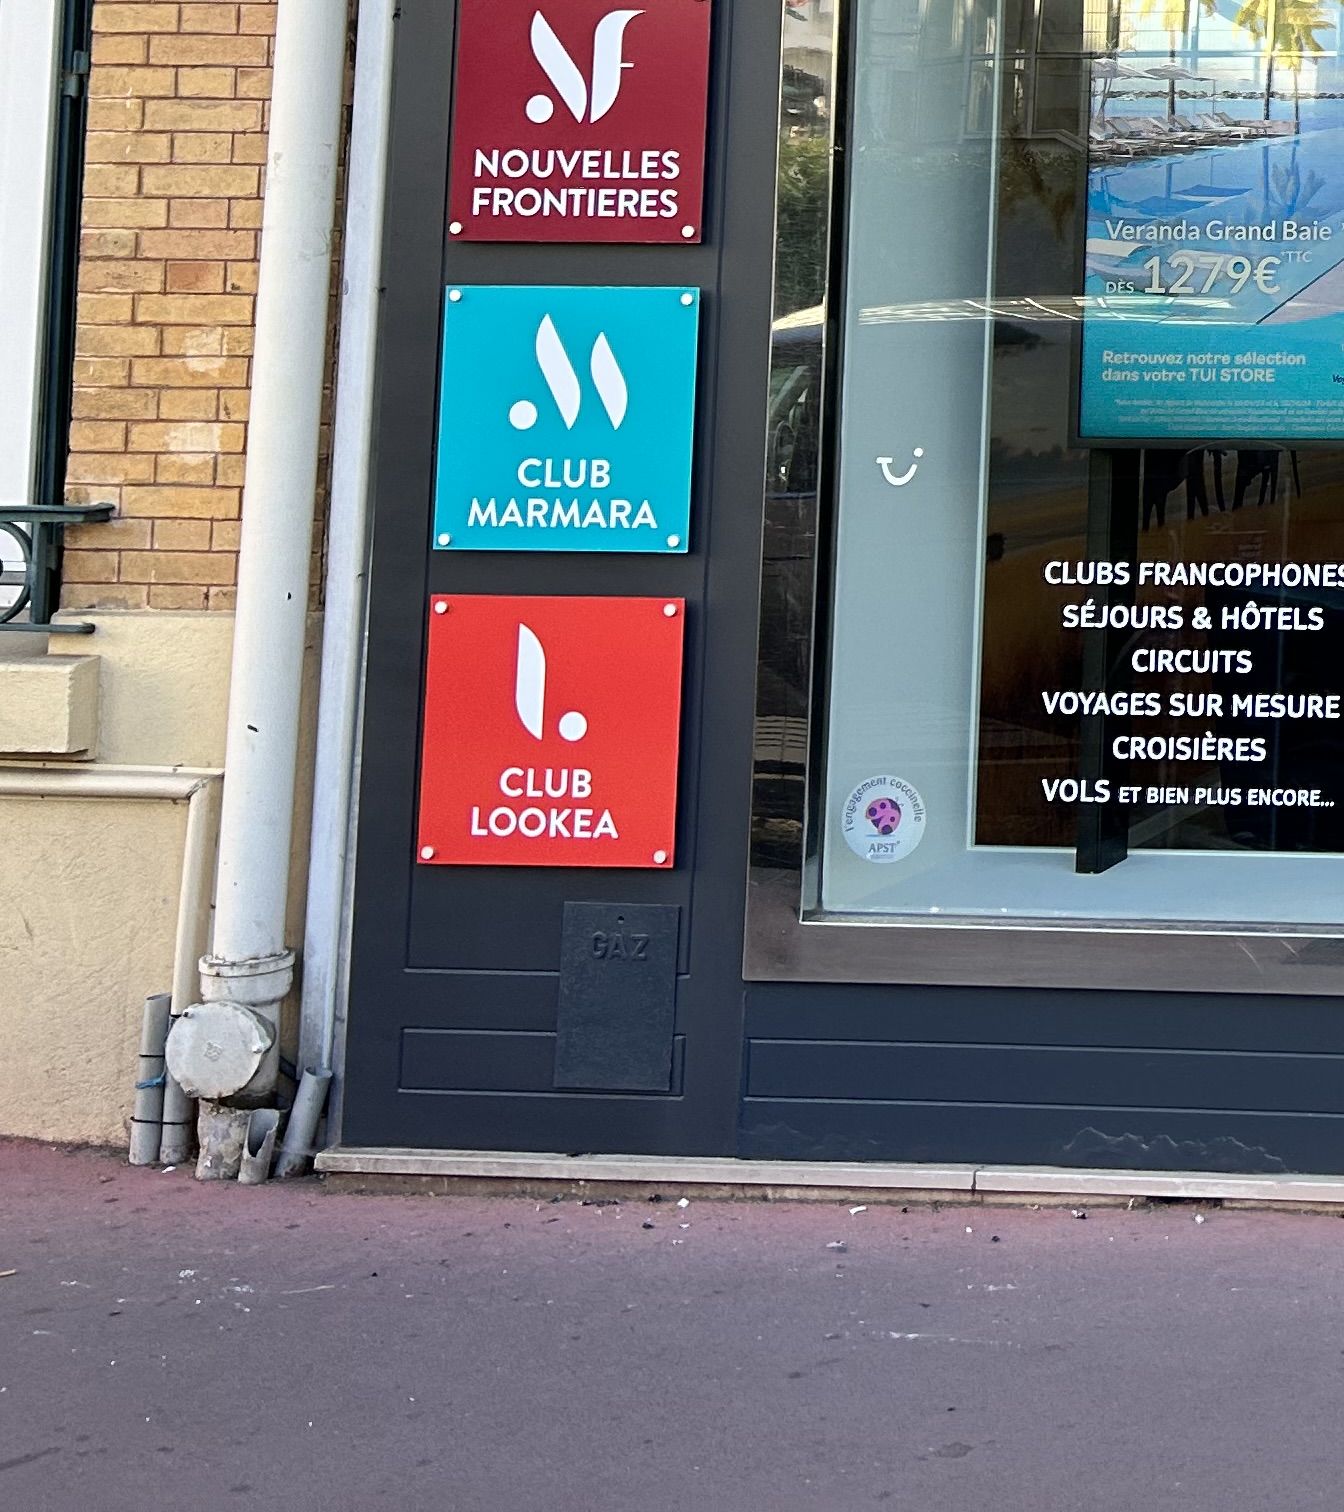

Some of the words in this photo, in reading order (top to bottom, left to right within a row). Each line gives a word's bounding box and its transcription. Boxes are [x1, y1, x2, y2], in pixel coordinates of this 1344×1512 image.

[473, 148, 681, 179] NOUVELLES
[471, 187, 679, 218] FRONTIERES
[1105, 220, 1201, 242] Veranda
[1205, 220, 1280, 242] Grand
[1282, 220, 1333, 242] Baie
[1105, 277, 1135, 294] DÈS
[1143, 255, 1282, 295] 1279€
[1102, 350, 1183, 366] Retrouvez
[1186, 351, 1231, 366] notre
[1234, 349, 1306, 366] sélection
[1102, 367, 1141, 383] dans
[1142, 369, 1186, 383] votre
[1189, 368, 1217, 383] TUI
[1219, 368, 1276, 384] STORE
[517, 458, 611, 488] CLUB
[467, 497, 658, 529] MARMARA
[1043, 561, 1131, 585] CLUBS
[1062, 599, 1184, 629] SÉJOURS
[1191, 605, 1212, 629] &
[1221, 601, 1325, 631] HÔTELS
[1131, 649, 1253, 674] CIRCUITS
[1041, 691, 1162, 717] VOYAGES
[1169, 693, 1224, 717] SUR
[1232, 694, 1341, 718] MESURE
[1112, 731, 1267, 762] CROISIÈRES
[499, 767, 592, 798] CLUB
[1041, 778, 1111, 804] VOLS
[1118, 786, 1142, 804] ET
[1146, 787, 1189, 805] BIEN
[1194, 788, 1242, 806] PLUS
[890, 778, 924, 822] coccinelle
[470, 806, 619, 839] LOOKEA
[591, 931, 649, 961] GAZ
